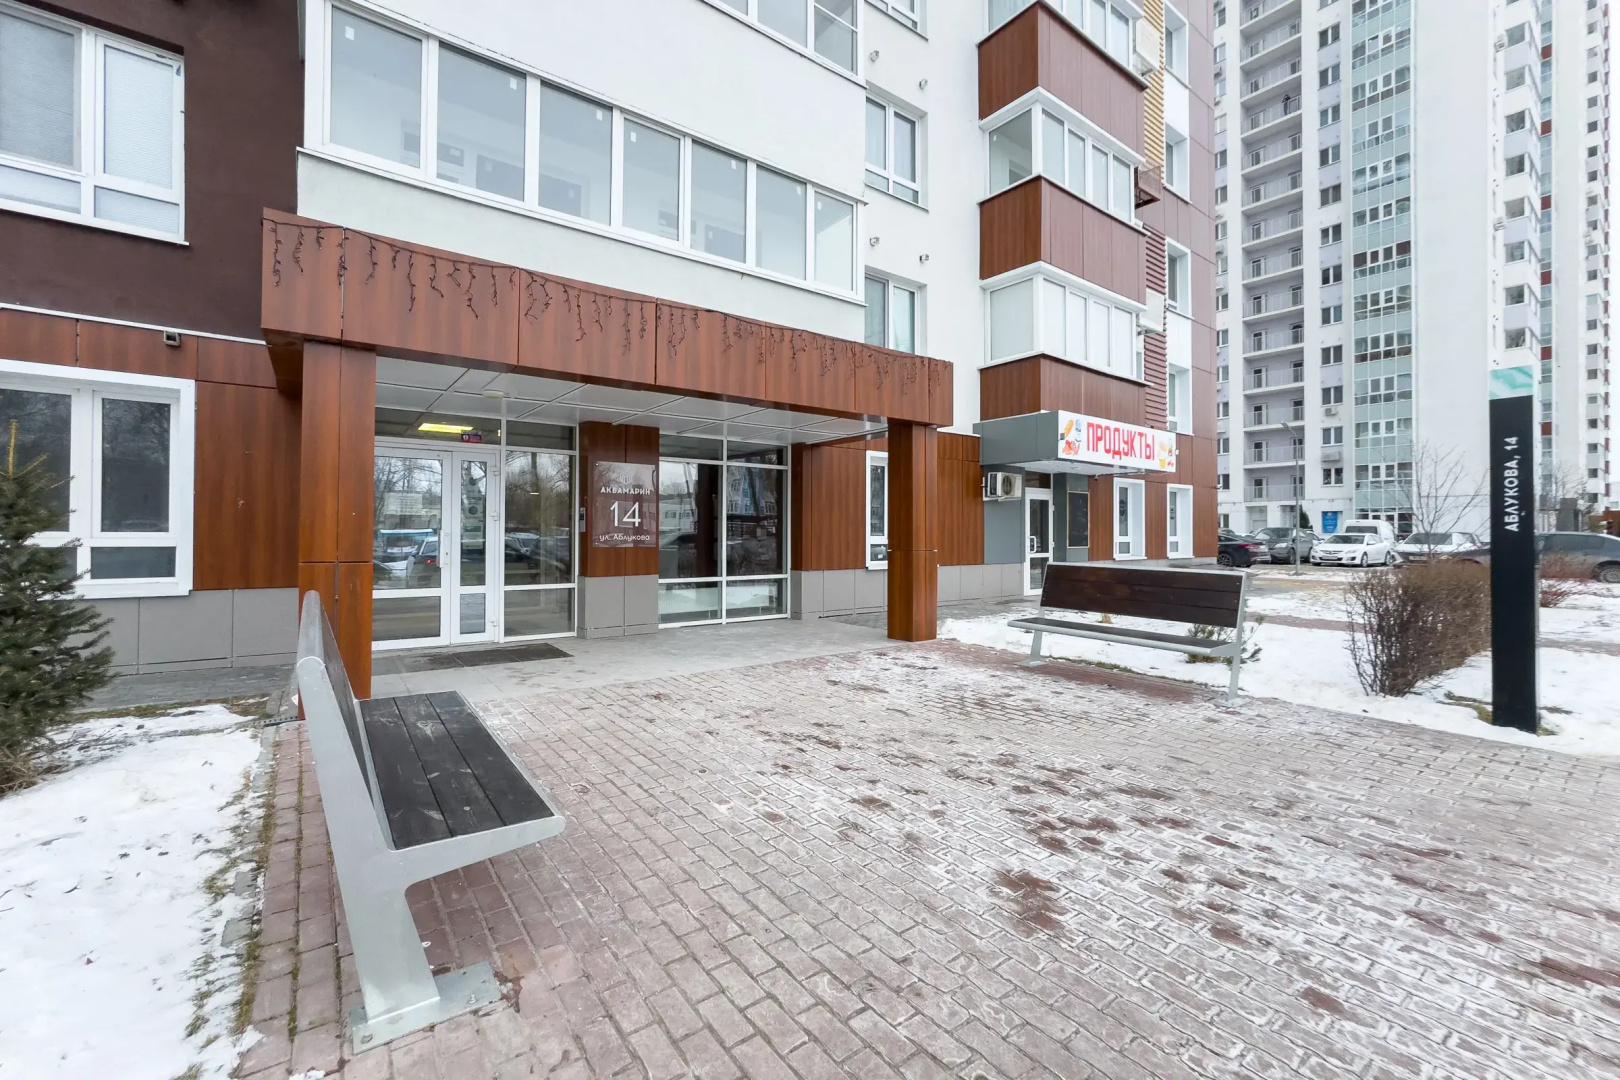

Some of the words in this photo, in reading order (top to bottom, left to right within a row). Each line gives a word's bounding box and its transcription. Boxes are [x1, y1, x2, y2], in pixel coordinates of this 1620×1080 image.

[1086, 422, 1155, 460] ПРОДУКТЫ
[1504, 436, 1519, 450] 14
[600, 486, 651, 495] АКВАМАРИН
[1504, 456, 1520, 532] АБЛУКОВА,
[610, 501, 641, 527] 14
